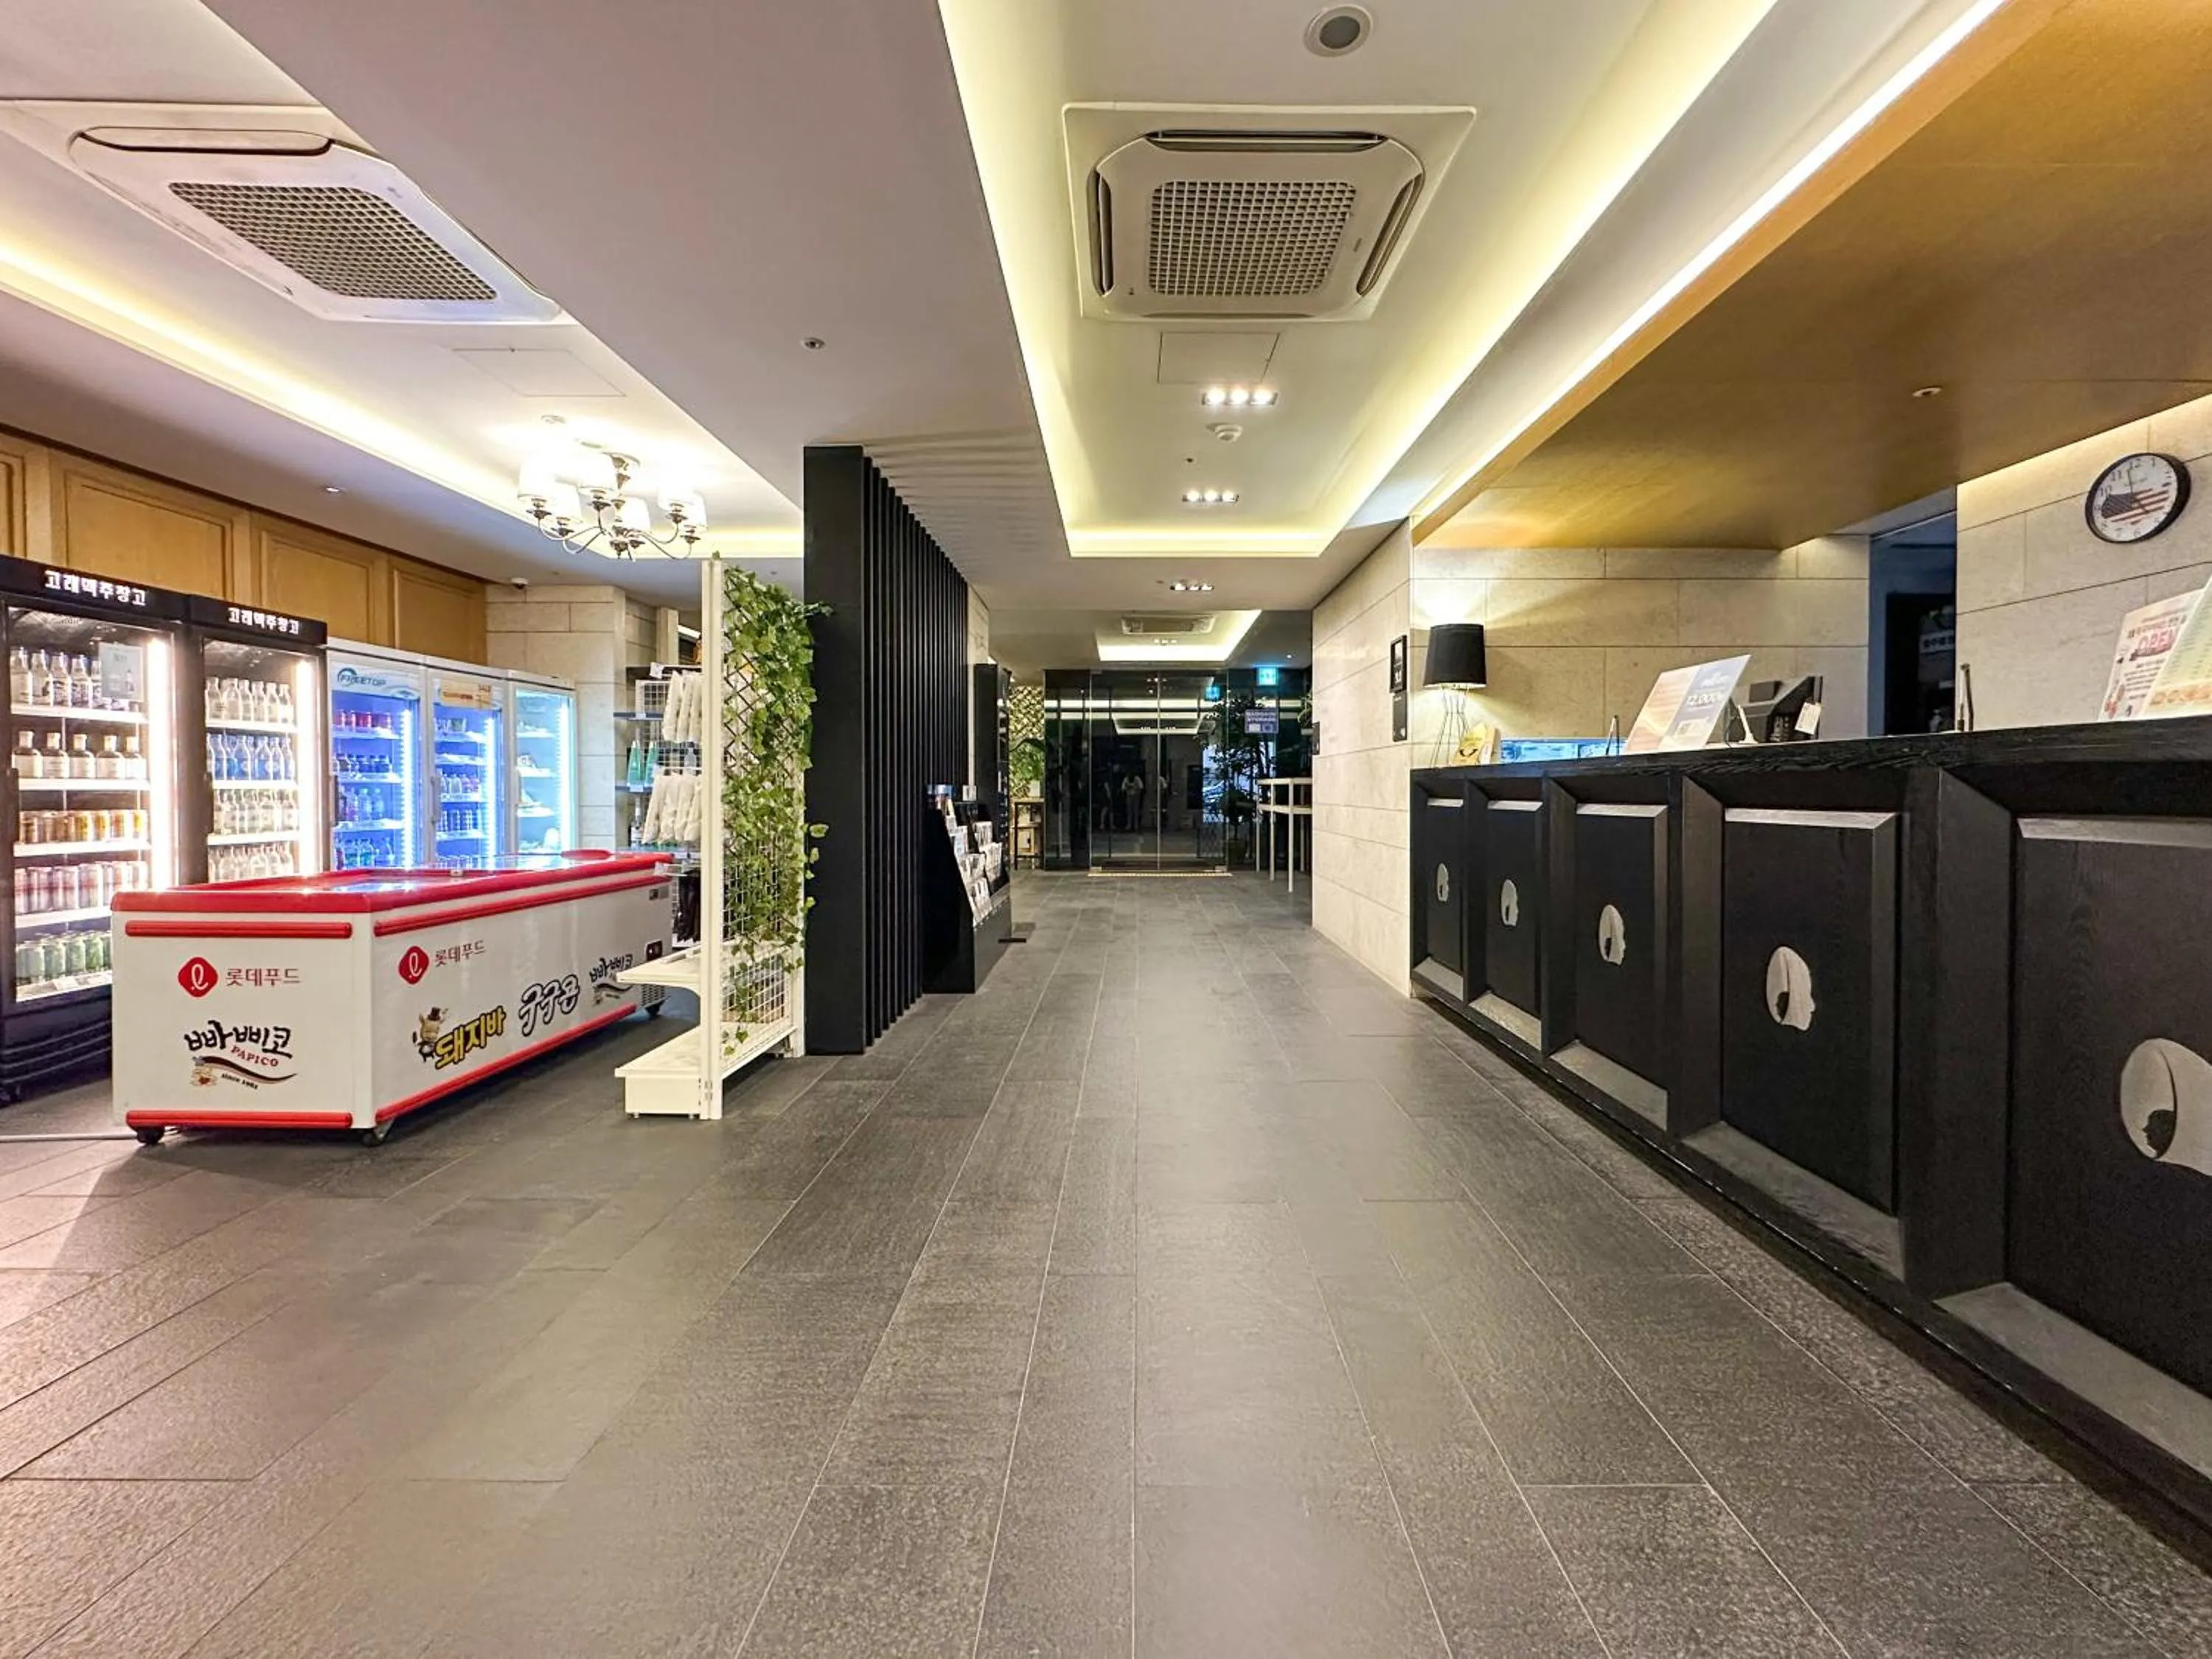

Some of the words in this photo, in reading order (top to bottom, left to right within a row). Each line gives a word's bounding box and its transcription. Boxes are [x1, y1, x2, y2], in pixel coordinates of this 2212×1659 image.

[44, 569, 146, 606] 고래맥주창고
[434, 939, 487, 967] 롯데푸드
[225, 967, 302, 987] 롯데푸드
[184, 1019, 293, 1059] 빠삐코
[434, 1005, 507, 1070] 돼지바
[230, 1045, 279, 1067] PAPICO
